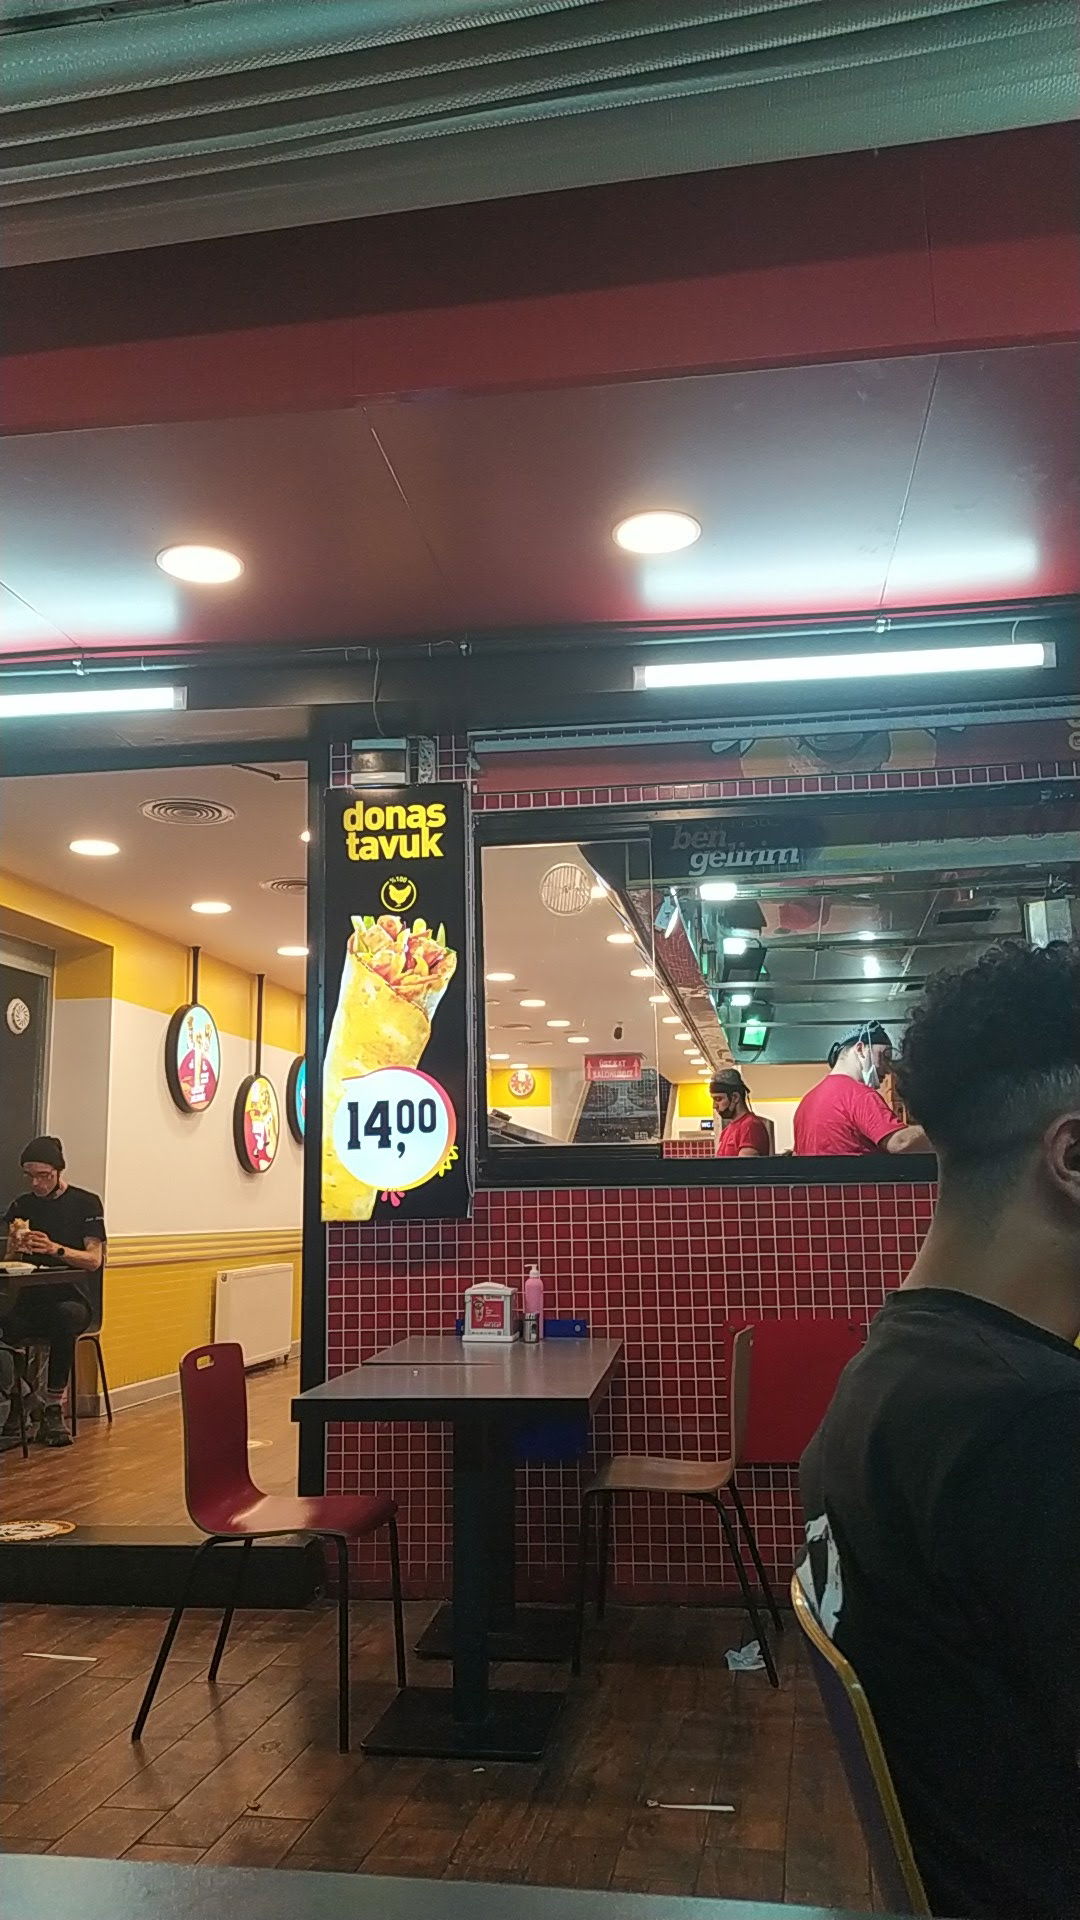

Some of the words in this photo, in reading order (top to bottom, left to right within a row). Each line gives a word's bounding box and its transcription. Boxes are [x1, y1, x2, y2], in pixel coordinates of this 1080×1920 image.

[343, 800, 447, 831] donas
[345, 826, 444, 861] tavuk
[671, 822, 727, 850] ben
